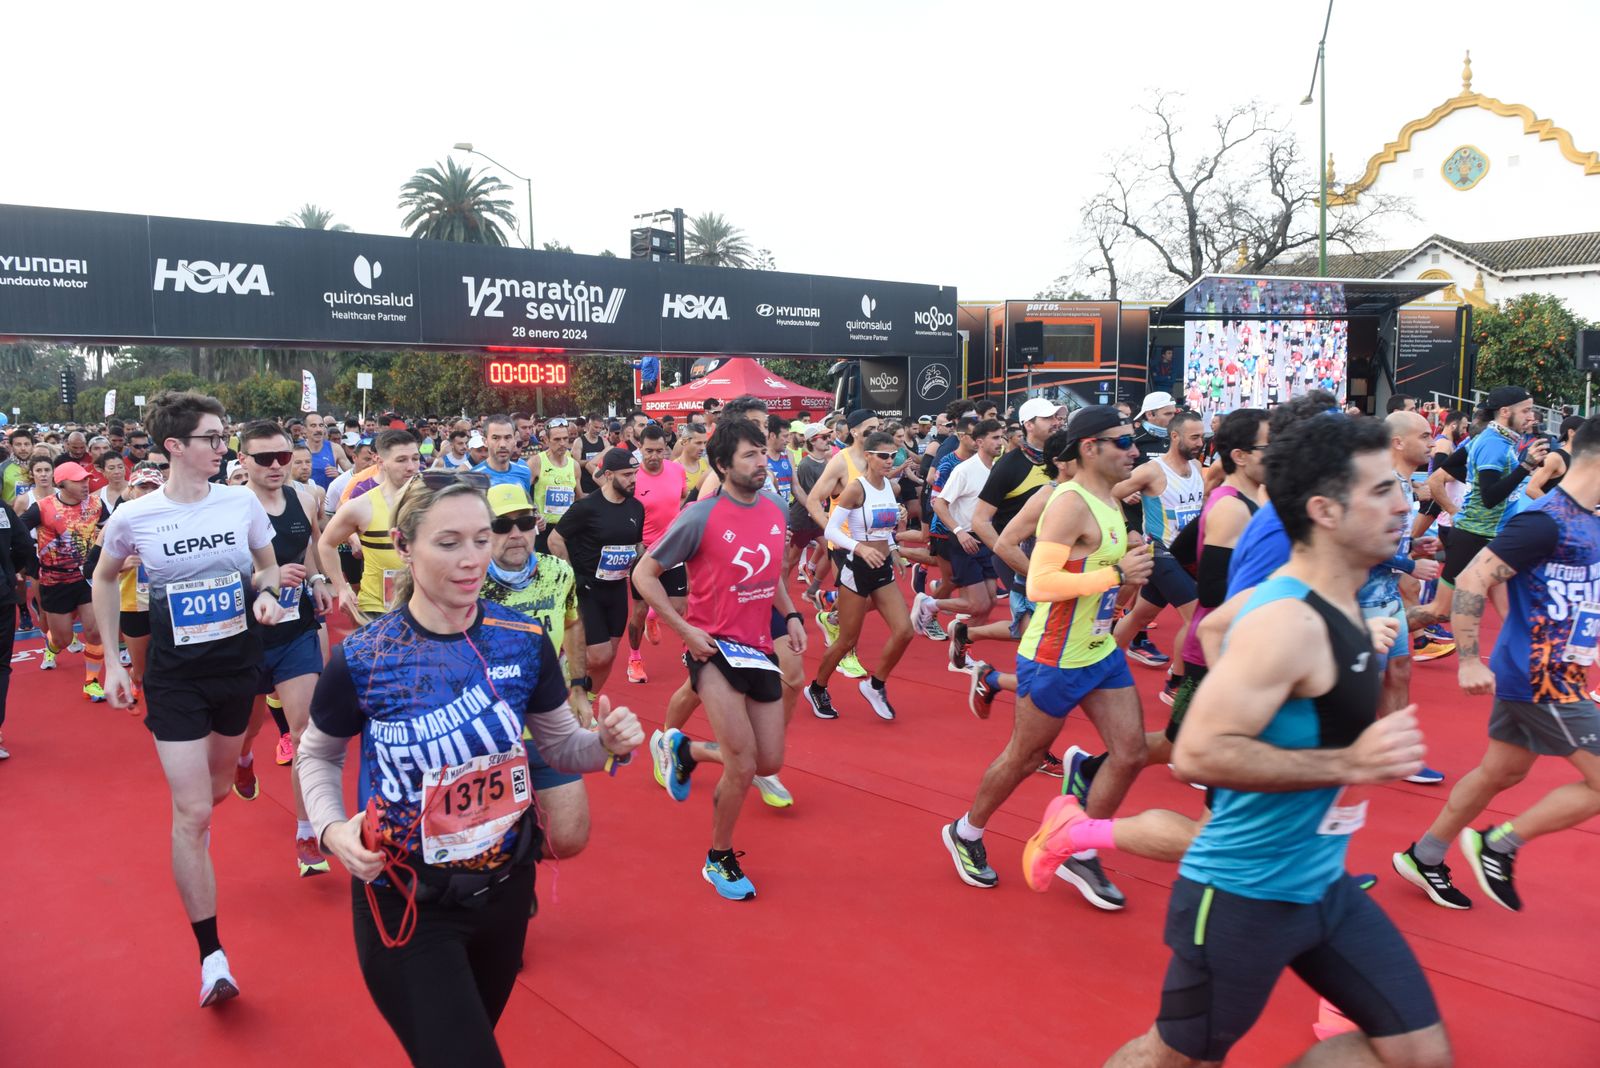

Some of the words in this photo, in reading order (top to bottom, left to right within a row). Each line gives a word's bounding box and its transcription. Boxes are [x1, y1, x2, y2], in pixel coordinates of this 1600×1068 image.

[53, 278, 88, 288] Motor
[153, 258, 271, 296] HOKA
[495, 279, 603, 303] maratón
[662, 293, 728, 320] HOKA
[776, 306, 820, 318] HYUNDAI
[331, 310, 376, 321] Healthcare
[377, 312, 407, 322] Partner
[776, 318, 804, 327] Hyundauto
[512, 326, 526, 338] 28
[528, 329, 560, 339] enero
[562, 329, 588, 340] 2024
[850, 333, 872, 341] Healthcare
[490, 363, 566, 383] 00:00:30
[550, 493, 569, 503] 1536
[163, 531, 236, 557] LEPAPE
[605, 554, 630, 566] 2053
[181, 591, 231, 616] 2019
[486, 664, 521, 679] HOKA
[370, 718, 409, 744] MEDIO
[411, 684, 491, 743] MARATÓN
[443, 770, 505, 815] 1375
